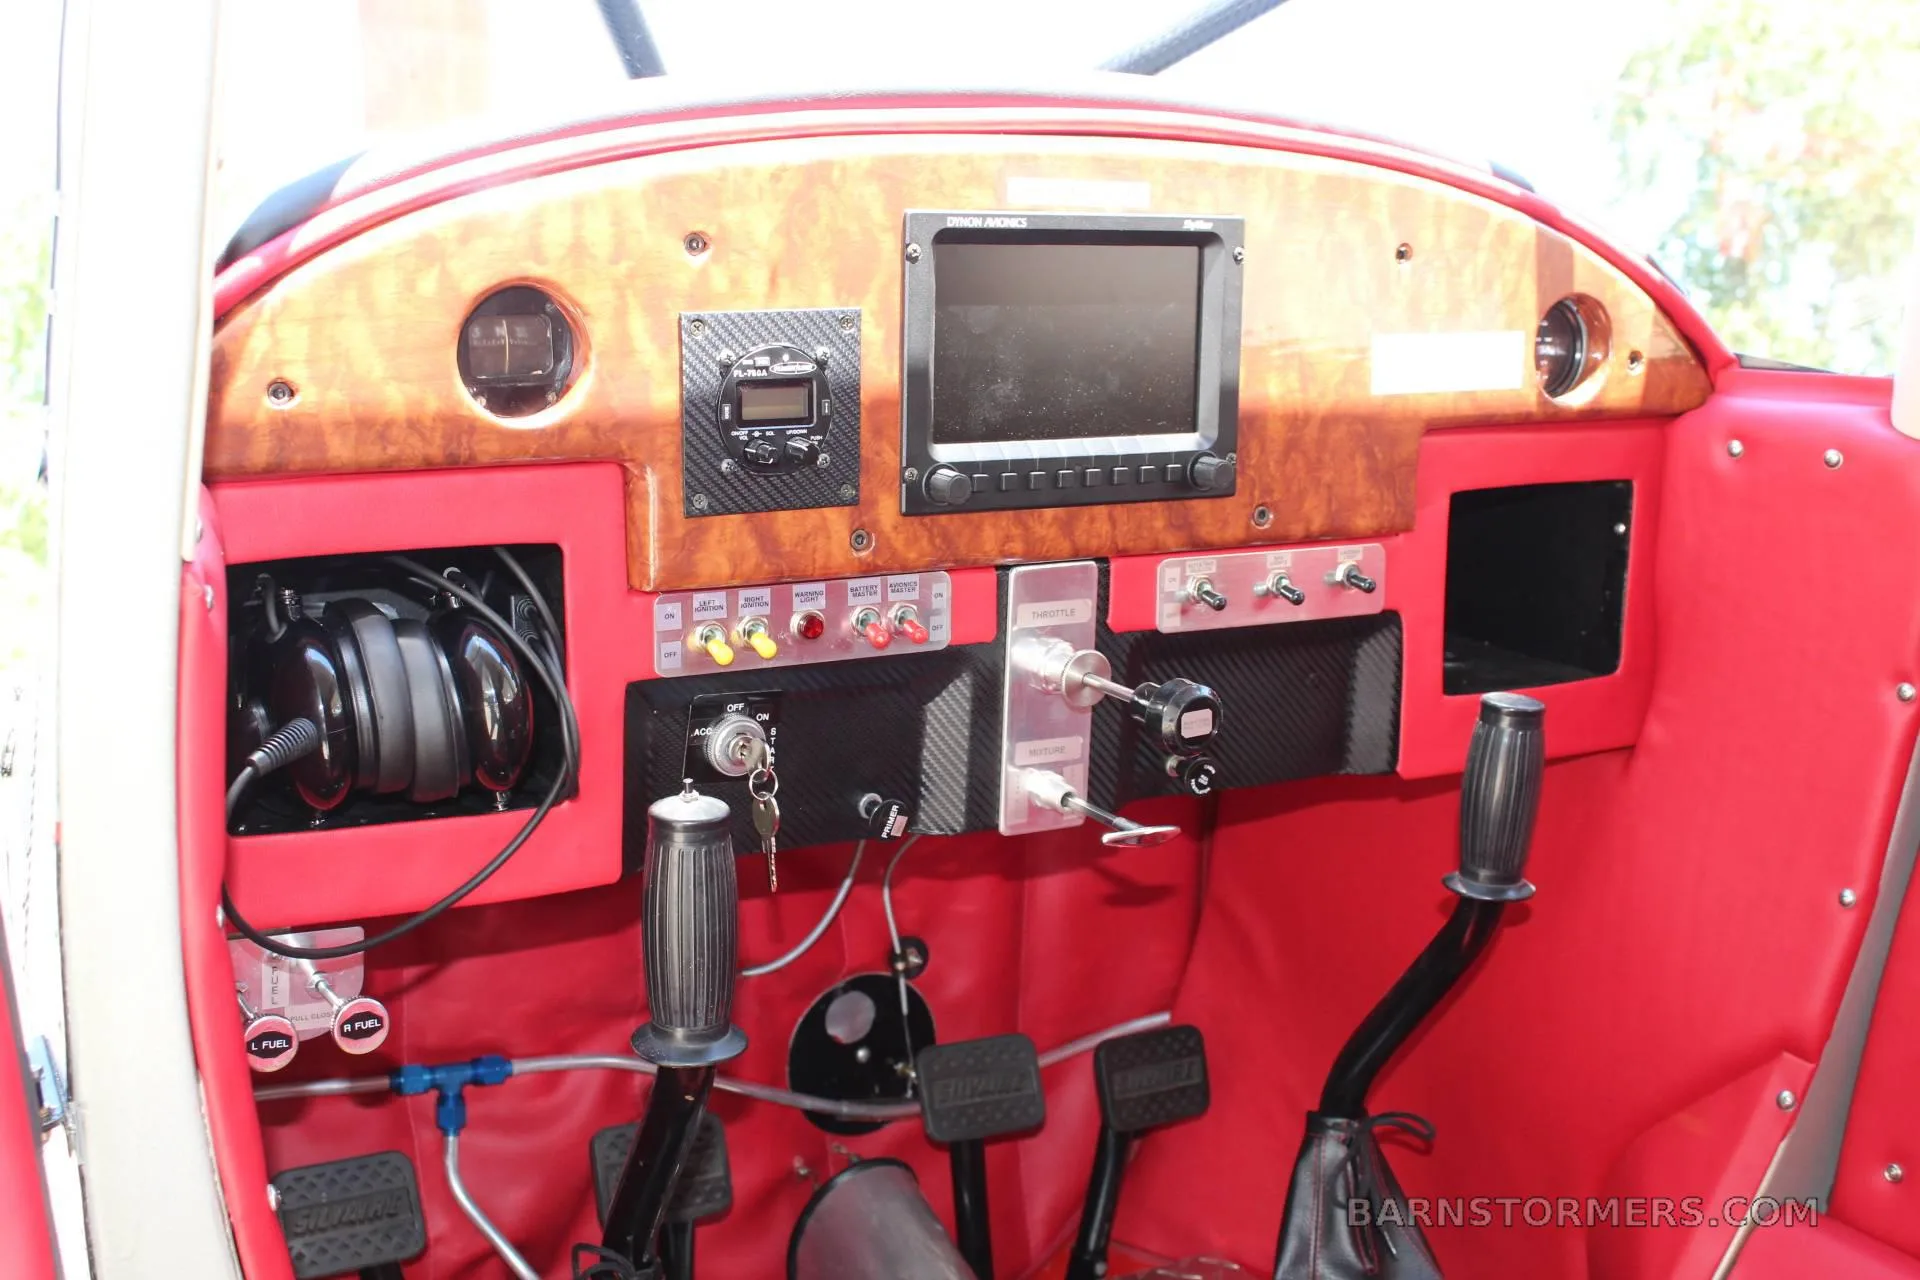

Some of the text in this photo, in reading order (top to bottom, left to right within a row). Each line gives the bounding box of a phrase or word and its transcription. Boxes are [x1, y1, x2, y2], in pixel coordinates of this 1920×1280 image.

[946, 215, 1028, 228] DYNON AVIONICS
[849, 584, 878, 593] BATTERY
[888, 581, 918, 589] AVIONICS
[794, 589, 824, 598] WARNING
[852, 590, 878, 598] MASTER
[890, 586, 916, 594] MASTER
[743, 595, 764, 603] RIGHT
[933, 591, 944, 599] ON
[694, 603, 724, 612] IGNITION
[698, 599, 716, 607] LEFT
[740, 600, 769, 609] IGNITION
[1031, 608, 1077, 621] THROTTLE
[931, 624, 944, 633] OFF
[663, 651, 677, 659] OFF
[726, 702, 745, 712] OFF
[756, 713, 770, 721] ON
[693, 727, 713, 737] ACC
[1028, 745, 1066, 757] MIXTURE
[880, 804, 900, 839] PRIMER
[271, 966, 279, 1005] FUEL
[343, 1018, 381, 1032] R FUEL
[251, 1039, 289, 1050] L FUEL
